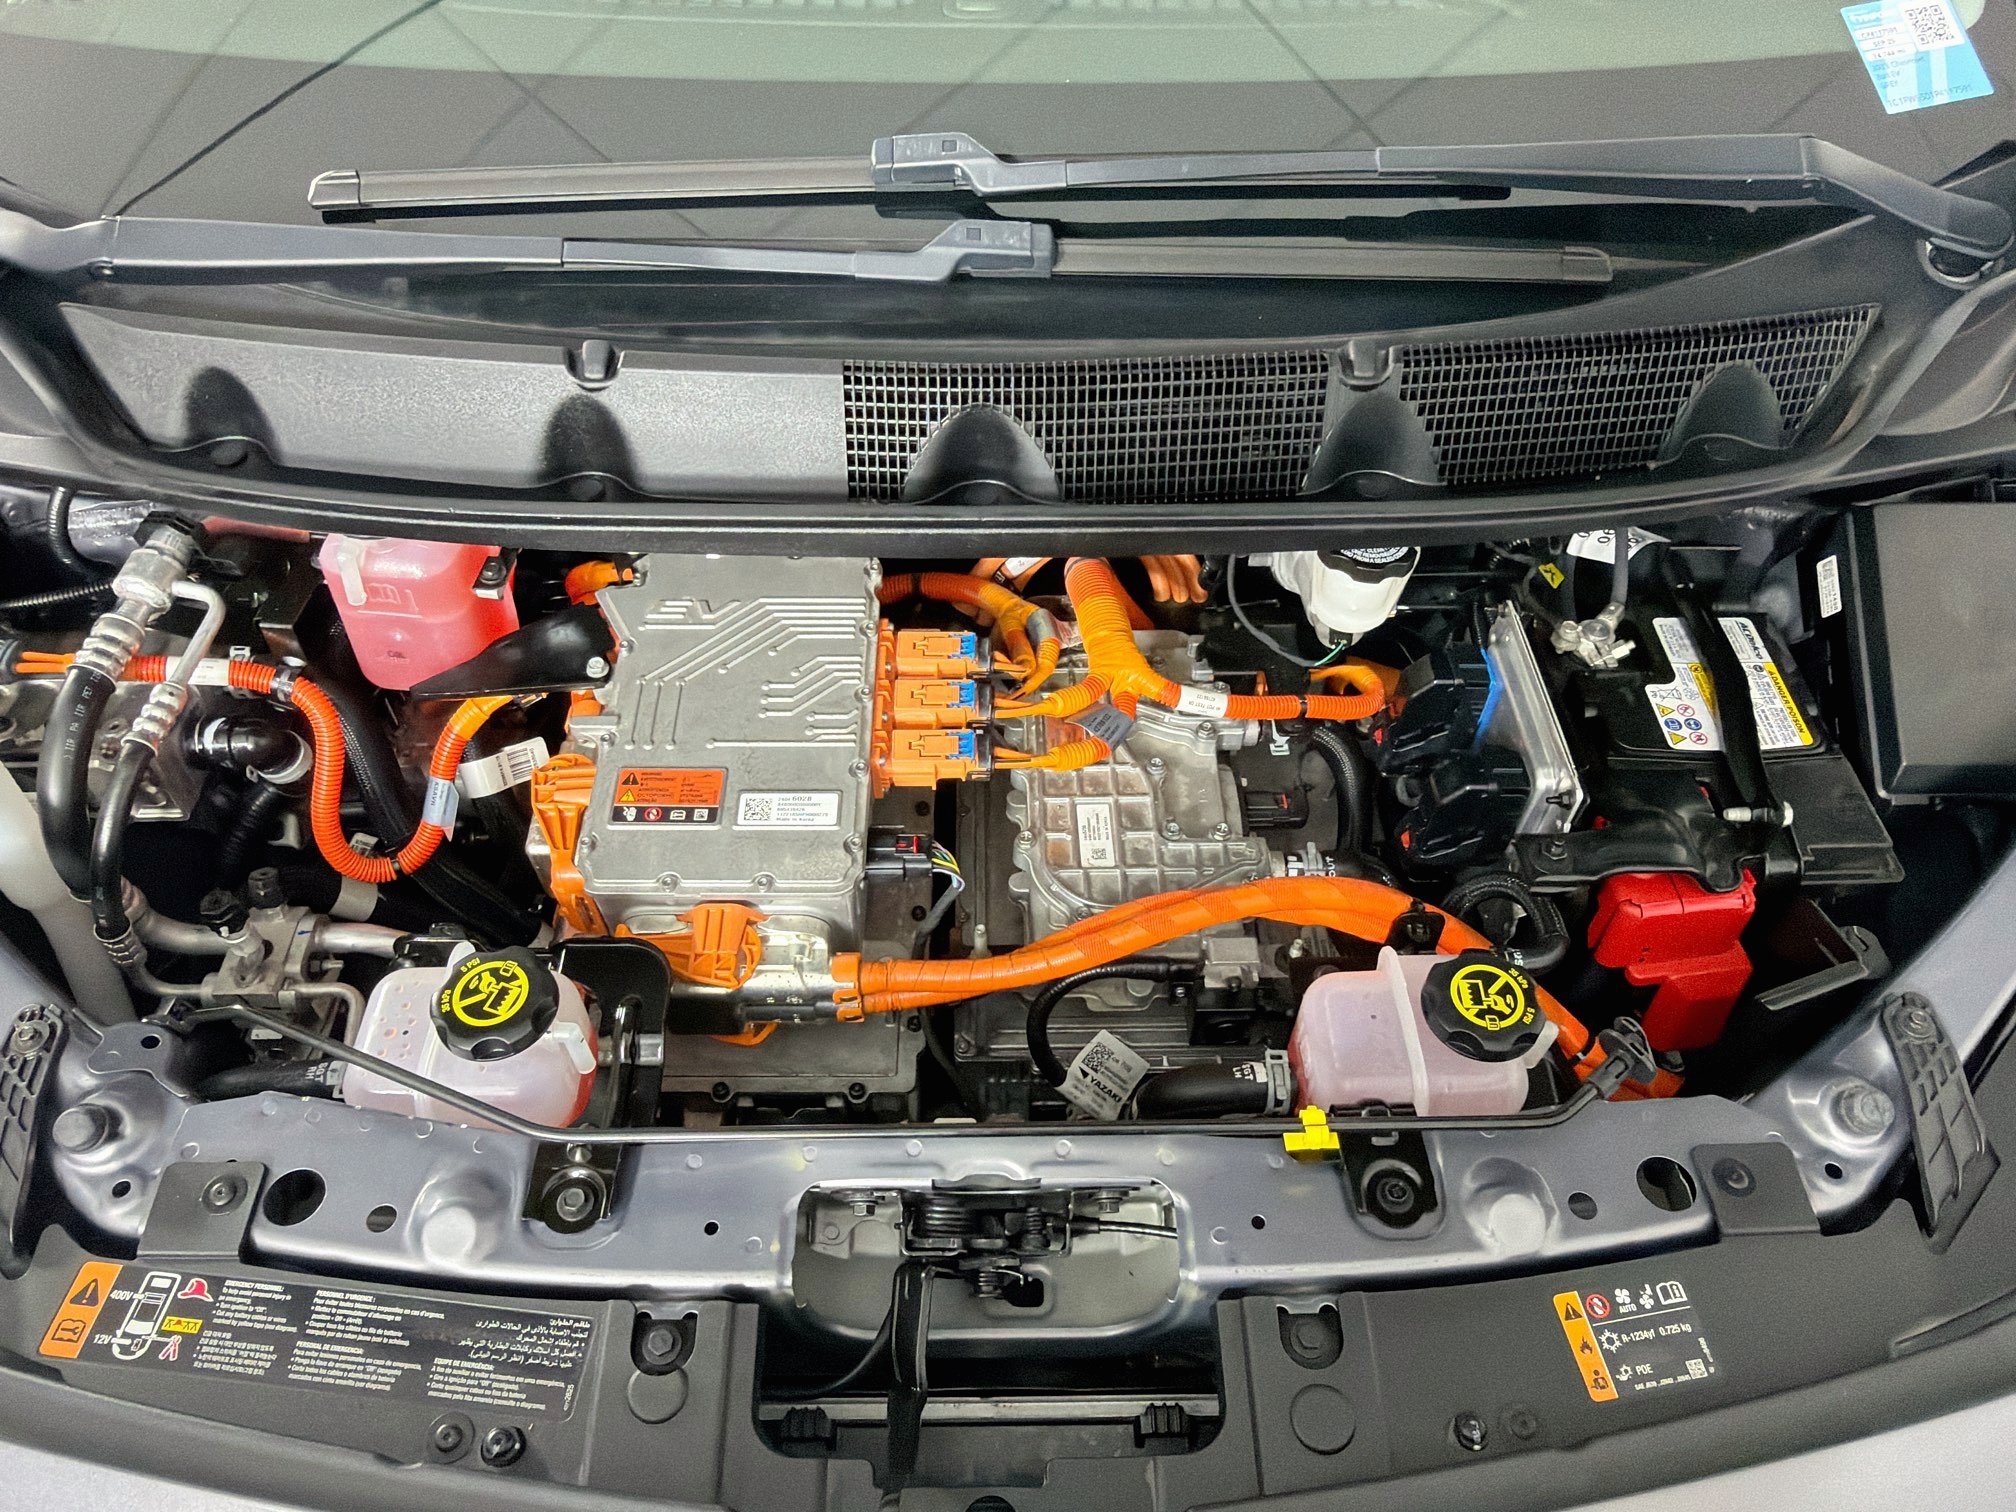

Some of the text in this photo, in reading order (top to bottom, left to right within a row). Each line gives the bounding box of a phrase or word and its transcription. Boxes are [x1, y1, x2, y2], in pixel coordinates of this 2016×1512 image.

[1740, 622, 1764, 660] ACDelco
[69, 722, 79, 732] PA
[82, 686, 92, 699] PET
[466, 957, 481, 969] PSI
[1508, 968, 1518, 978] 35
[305, 1066, 317, 1079] RH
[1232, 1066, 1242, 1078] LH
[1241, 1064, 1254, 1080] SGT
[1090, 1075, 1122, 1102] YAZAKI
[110, 1290, 134, 1300] 400V
[1619, 1304, 1637, 1313] AUTO
[1621, 1323, 1692, 1342] R-1234yf 0.725 kg
[94, 1334, 112, 1344] 12V
[1636, 1364, 1653, 1375] POE
